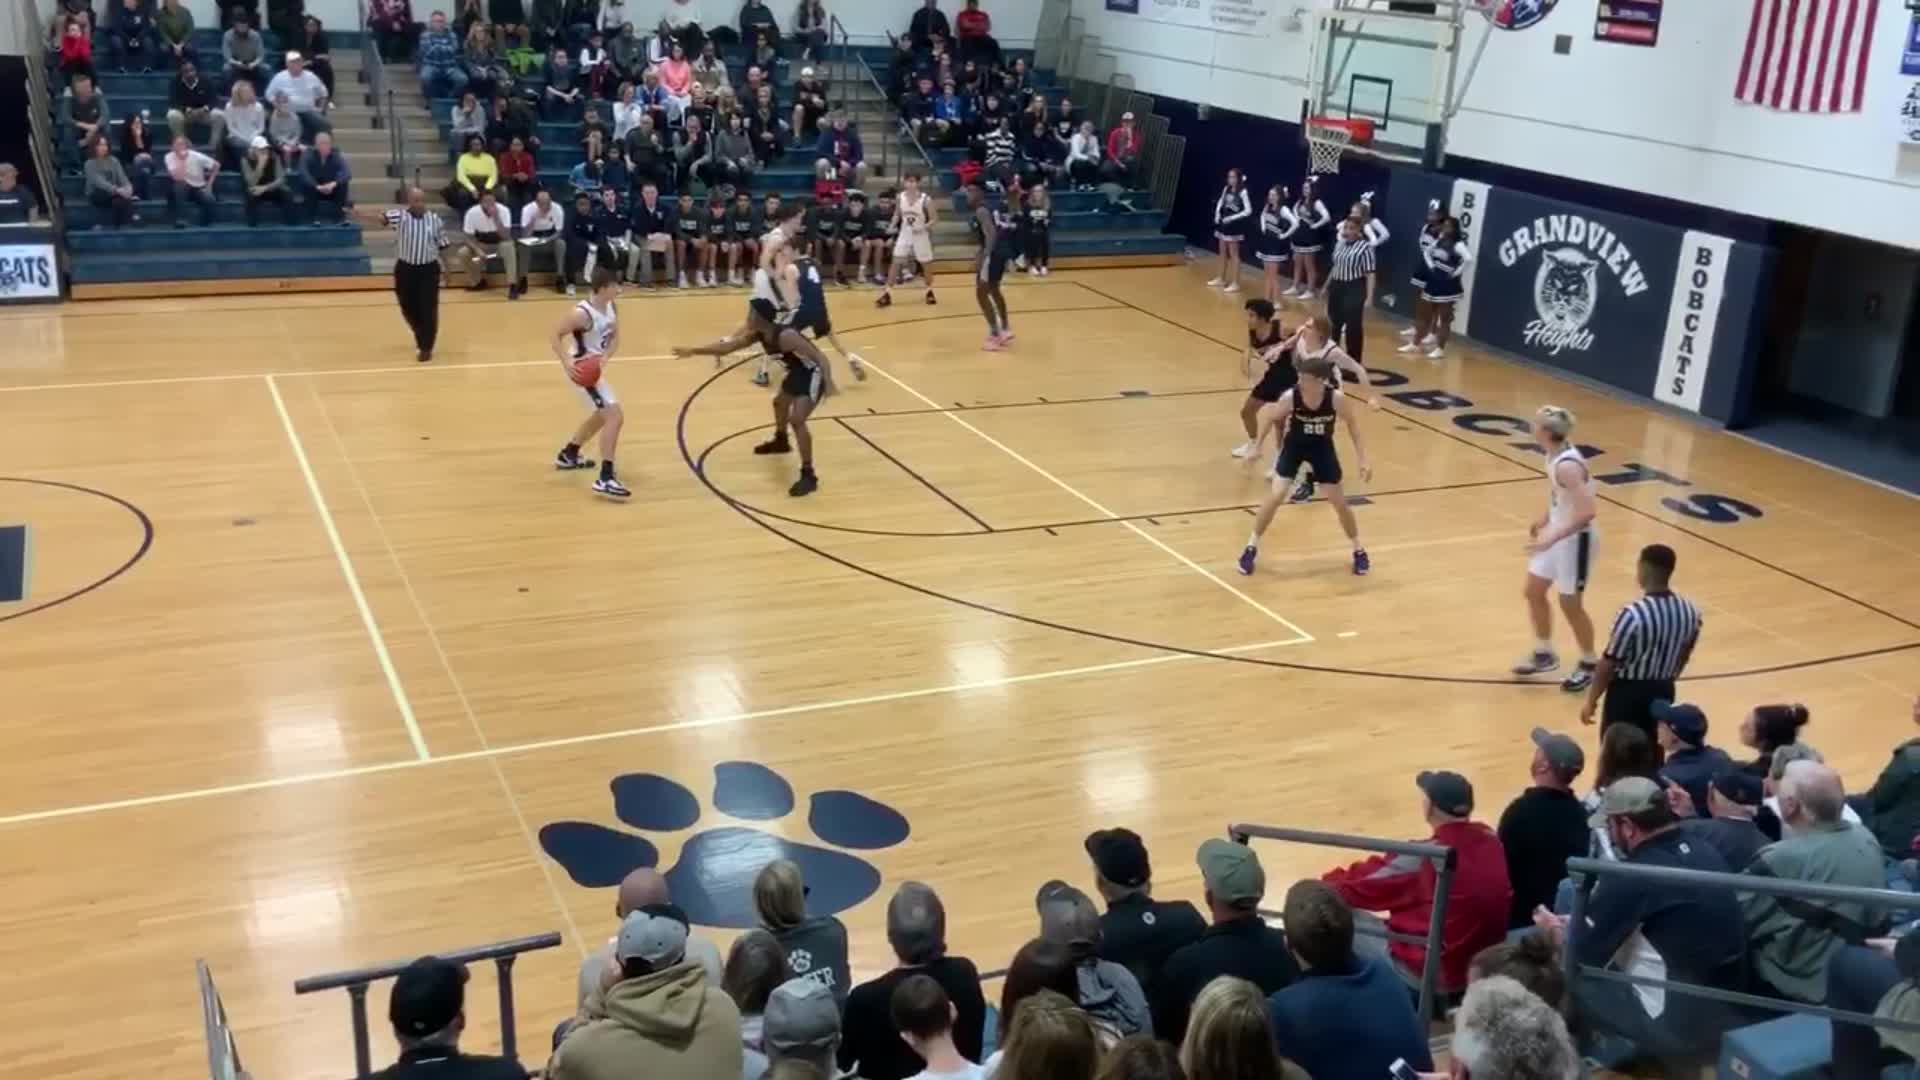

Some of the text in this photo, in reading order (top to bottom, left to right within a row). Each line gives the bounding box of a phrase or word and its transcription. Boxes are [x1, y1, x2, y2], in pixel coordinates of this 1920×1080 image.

[1499, 214, 1649, 297] GRANDVIEW
[1523, 319, 1596, 355] Heights
[1671, 246, 1713, 396] BOBCATS
